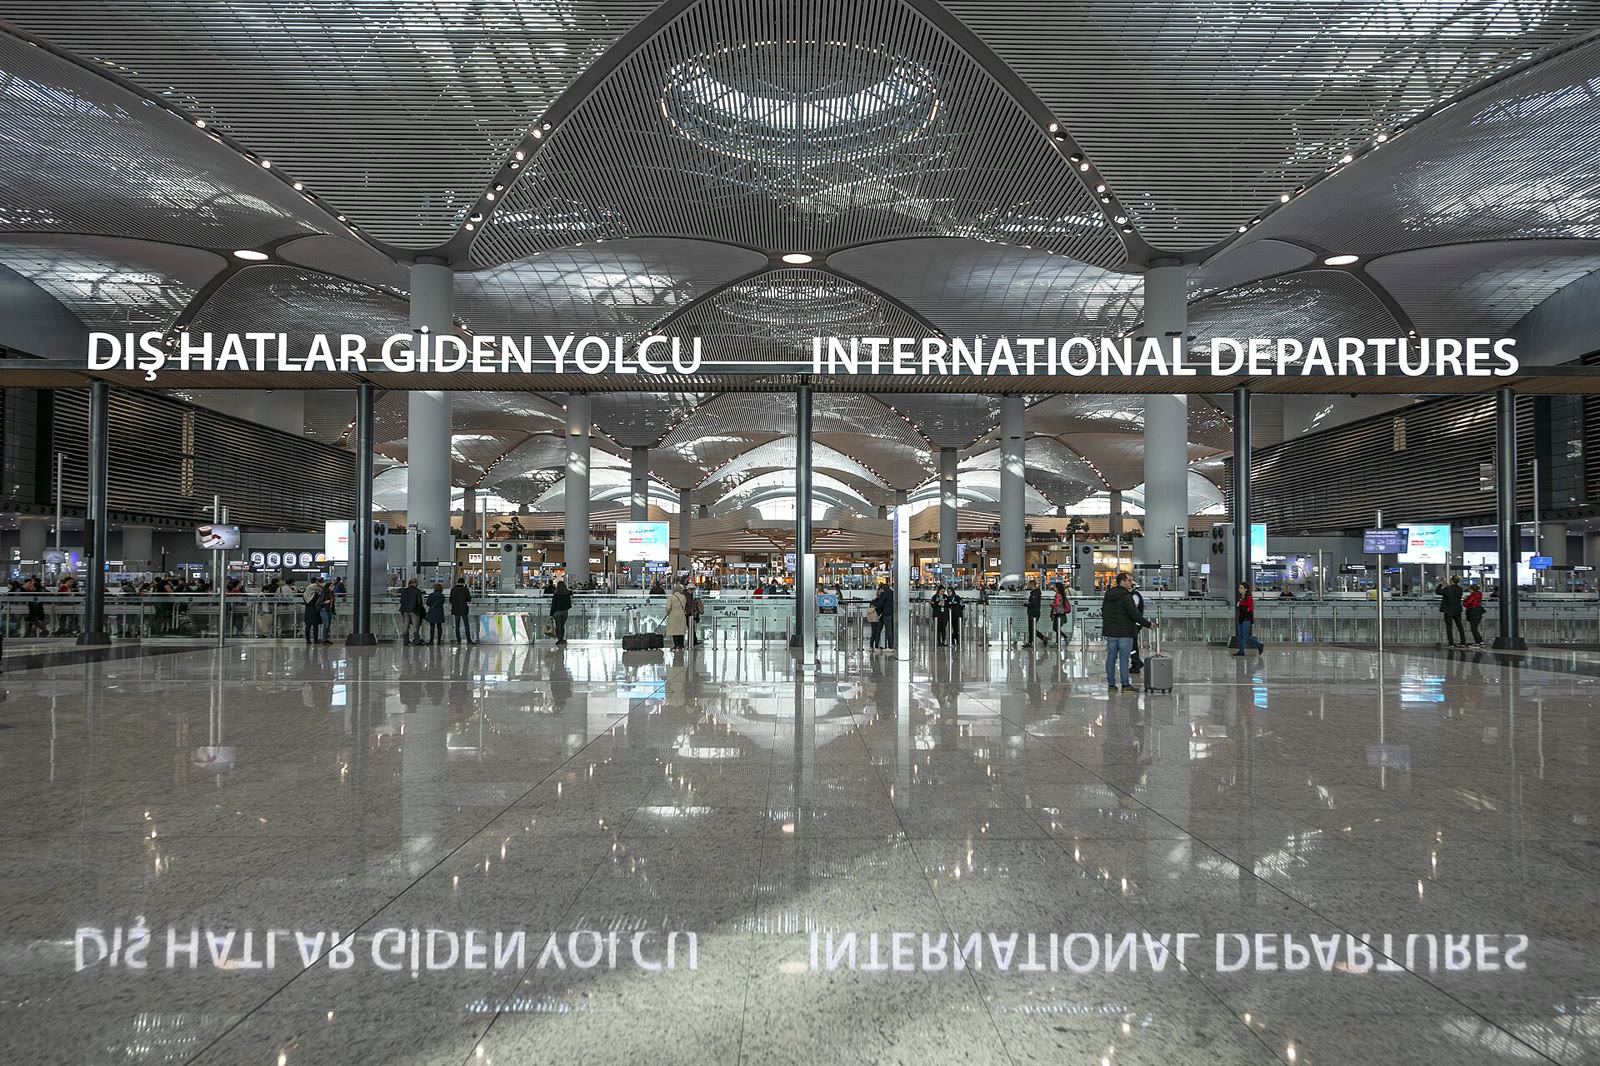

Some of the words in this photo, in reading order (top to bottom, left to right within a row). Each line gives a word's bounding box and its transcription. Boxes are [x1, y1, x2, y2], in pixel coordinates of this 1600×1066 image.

[87, 331, 166, 381] DIŞ
[180, 332, 368, 371] HATLAR
[381, 325, 532, 372] GİDEN
[544, 334, 702, 374] YOLCU
[812, 336, 1196, 376] INTERNATIONAL
[1210, 336, 1519, 376] DEPARTURES
